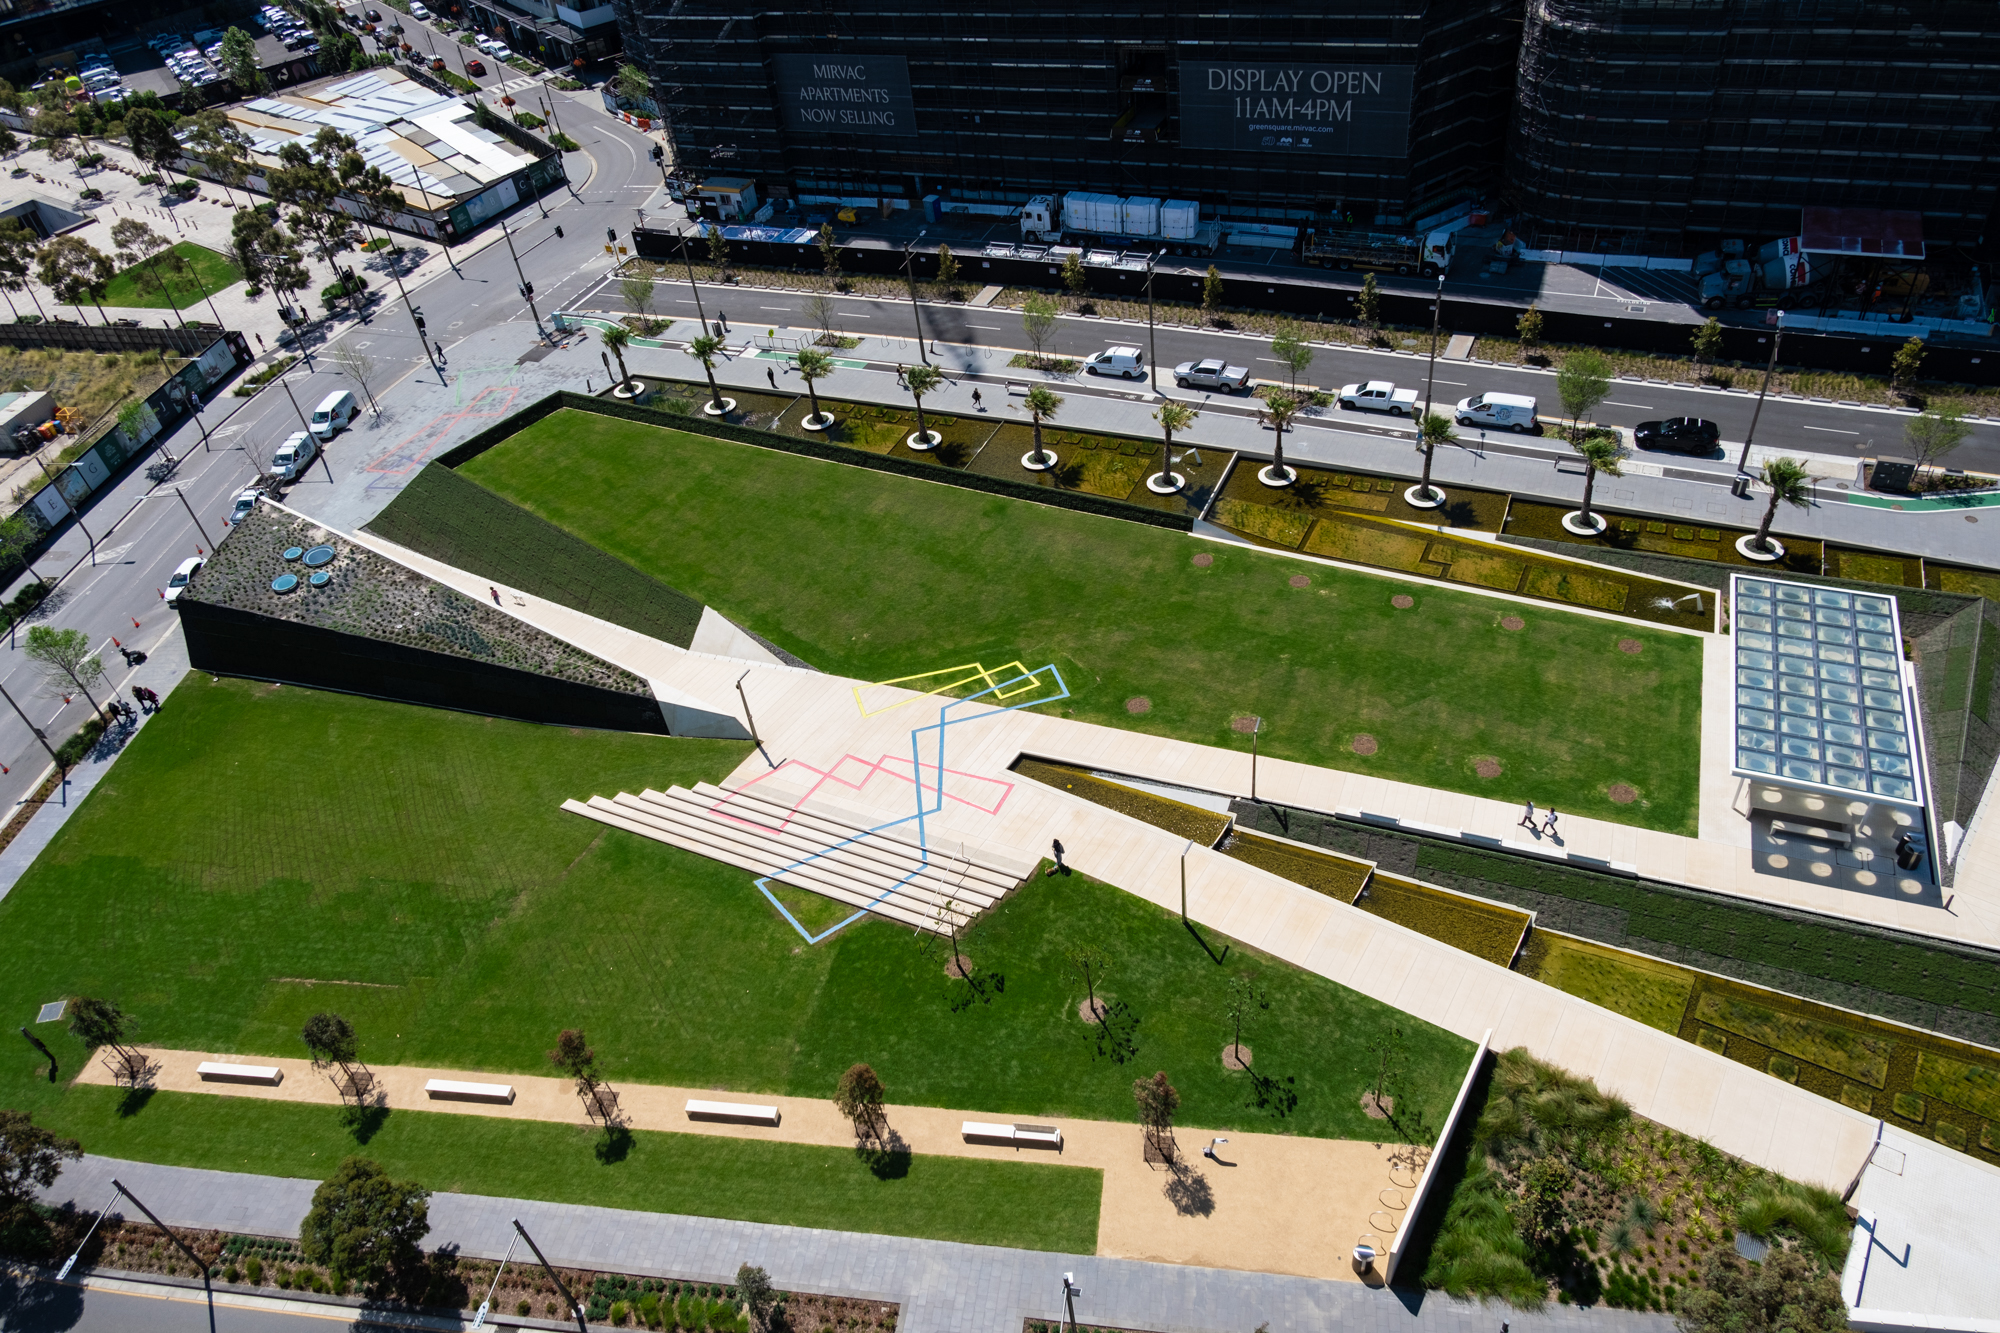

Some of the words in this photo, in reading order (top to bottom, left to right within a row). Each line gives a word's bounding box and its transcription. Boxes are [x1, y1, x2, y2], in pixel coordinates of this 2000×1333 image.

[813, 64, 866, 80] MIRVAC
[1208, 68, 1304, 92] DISPLAY
[1310, 70, 1382, 95] OPEN
[800, 86, 889, 104] APARTMENTS
[800, 108, 836, 122] NOW
[839, 110, 895, 126] SELLING
[1235, 96, 1352, 122] 11AM-4PM
[1248, 123, 1334, 134] greensquare.mirvac.com
[88, 462, 98, 474] G
[47, 498, 58, 510] E
